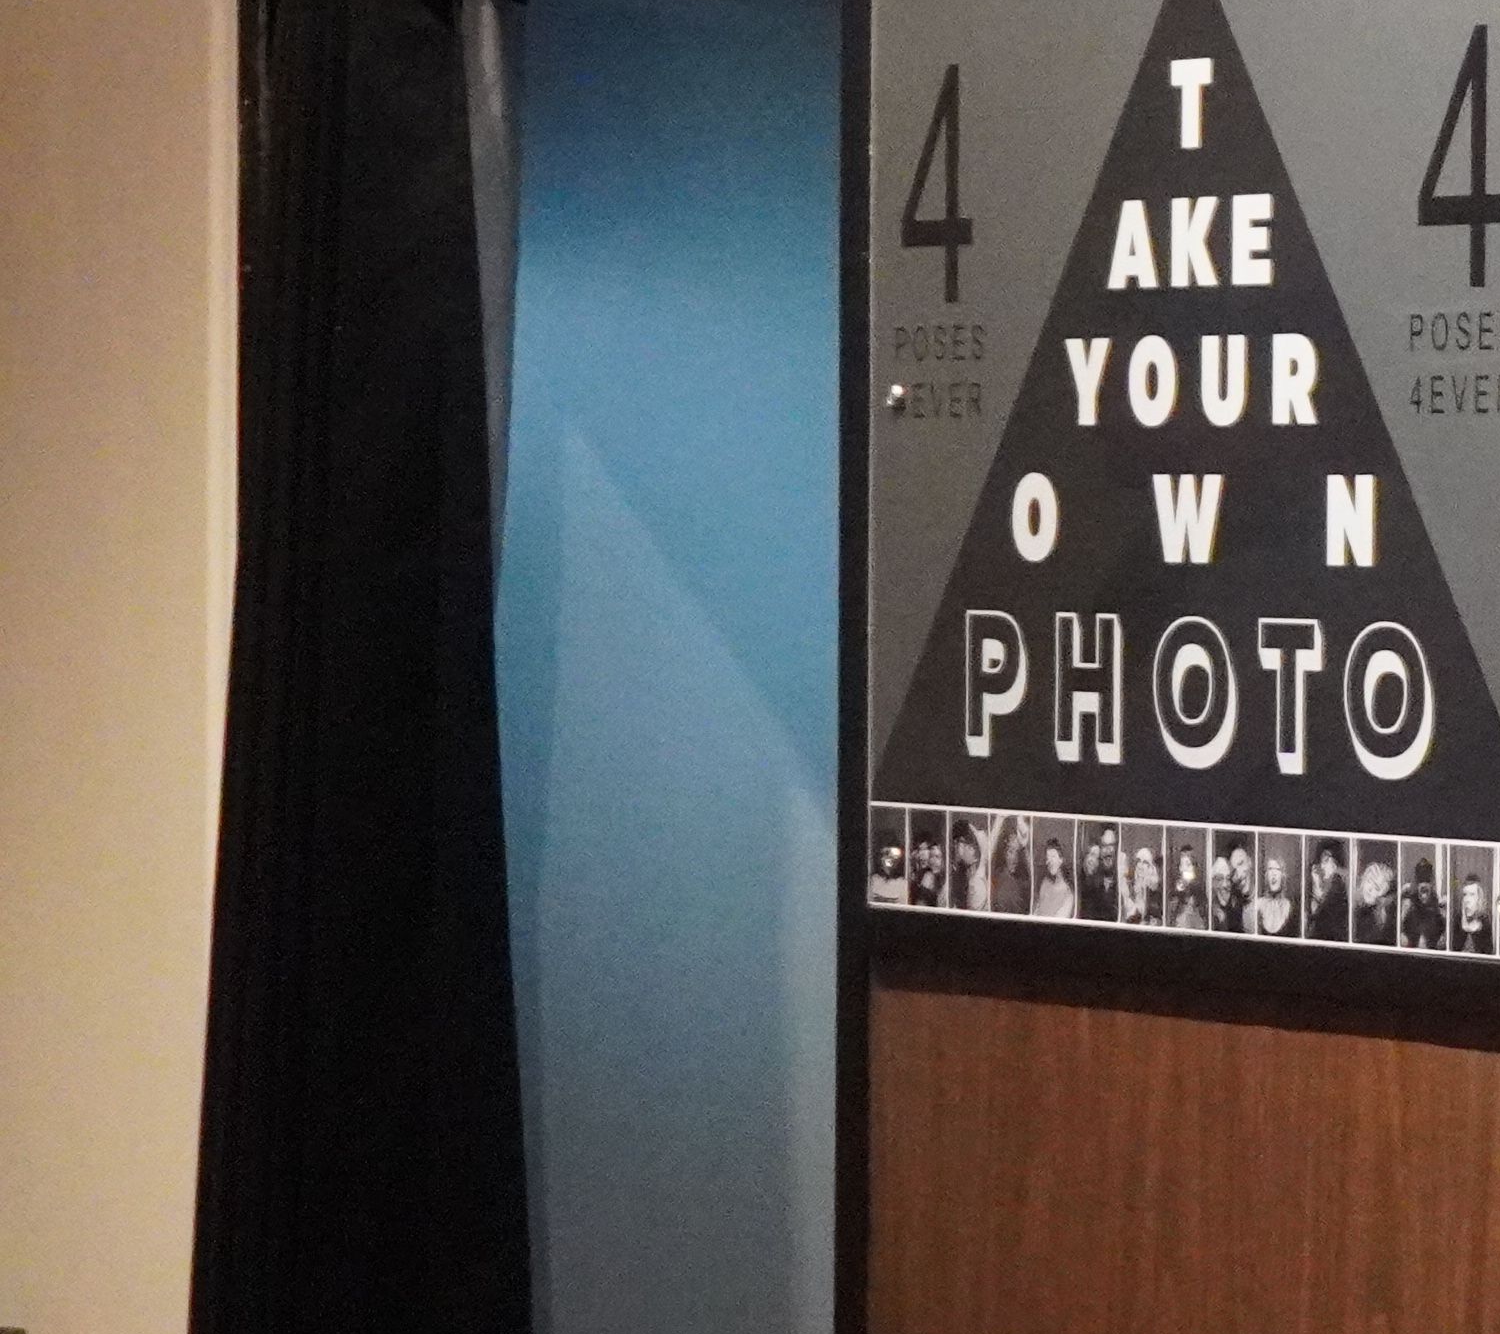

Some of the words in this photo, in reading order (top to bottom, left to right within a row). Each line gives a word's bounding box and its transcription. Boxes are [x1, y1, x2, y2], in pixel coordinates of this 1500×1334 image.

[1170, 57, 1214, 149] T
[903, 64, 973, 303] 4
[1107, 194, 1275, 290] AKE
[893, 324, 987, 361] POSES
[1064, 333, 1320, 427] YOUR
[965, 609, 1435, 781] PHOTO
